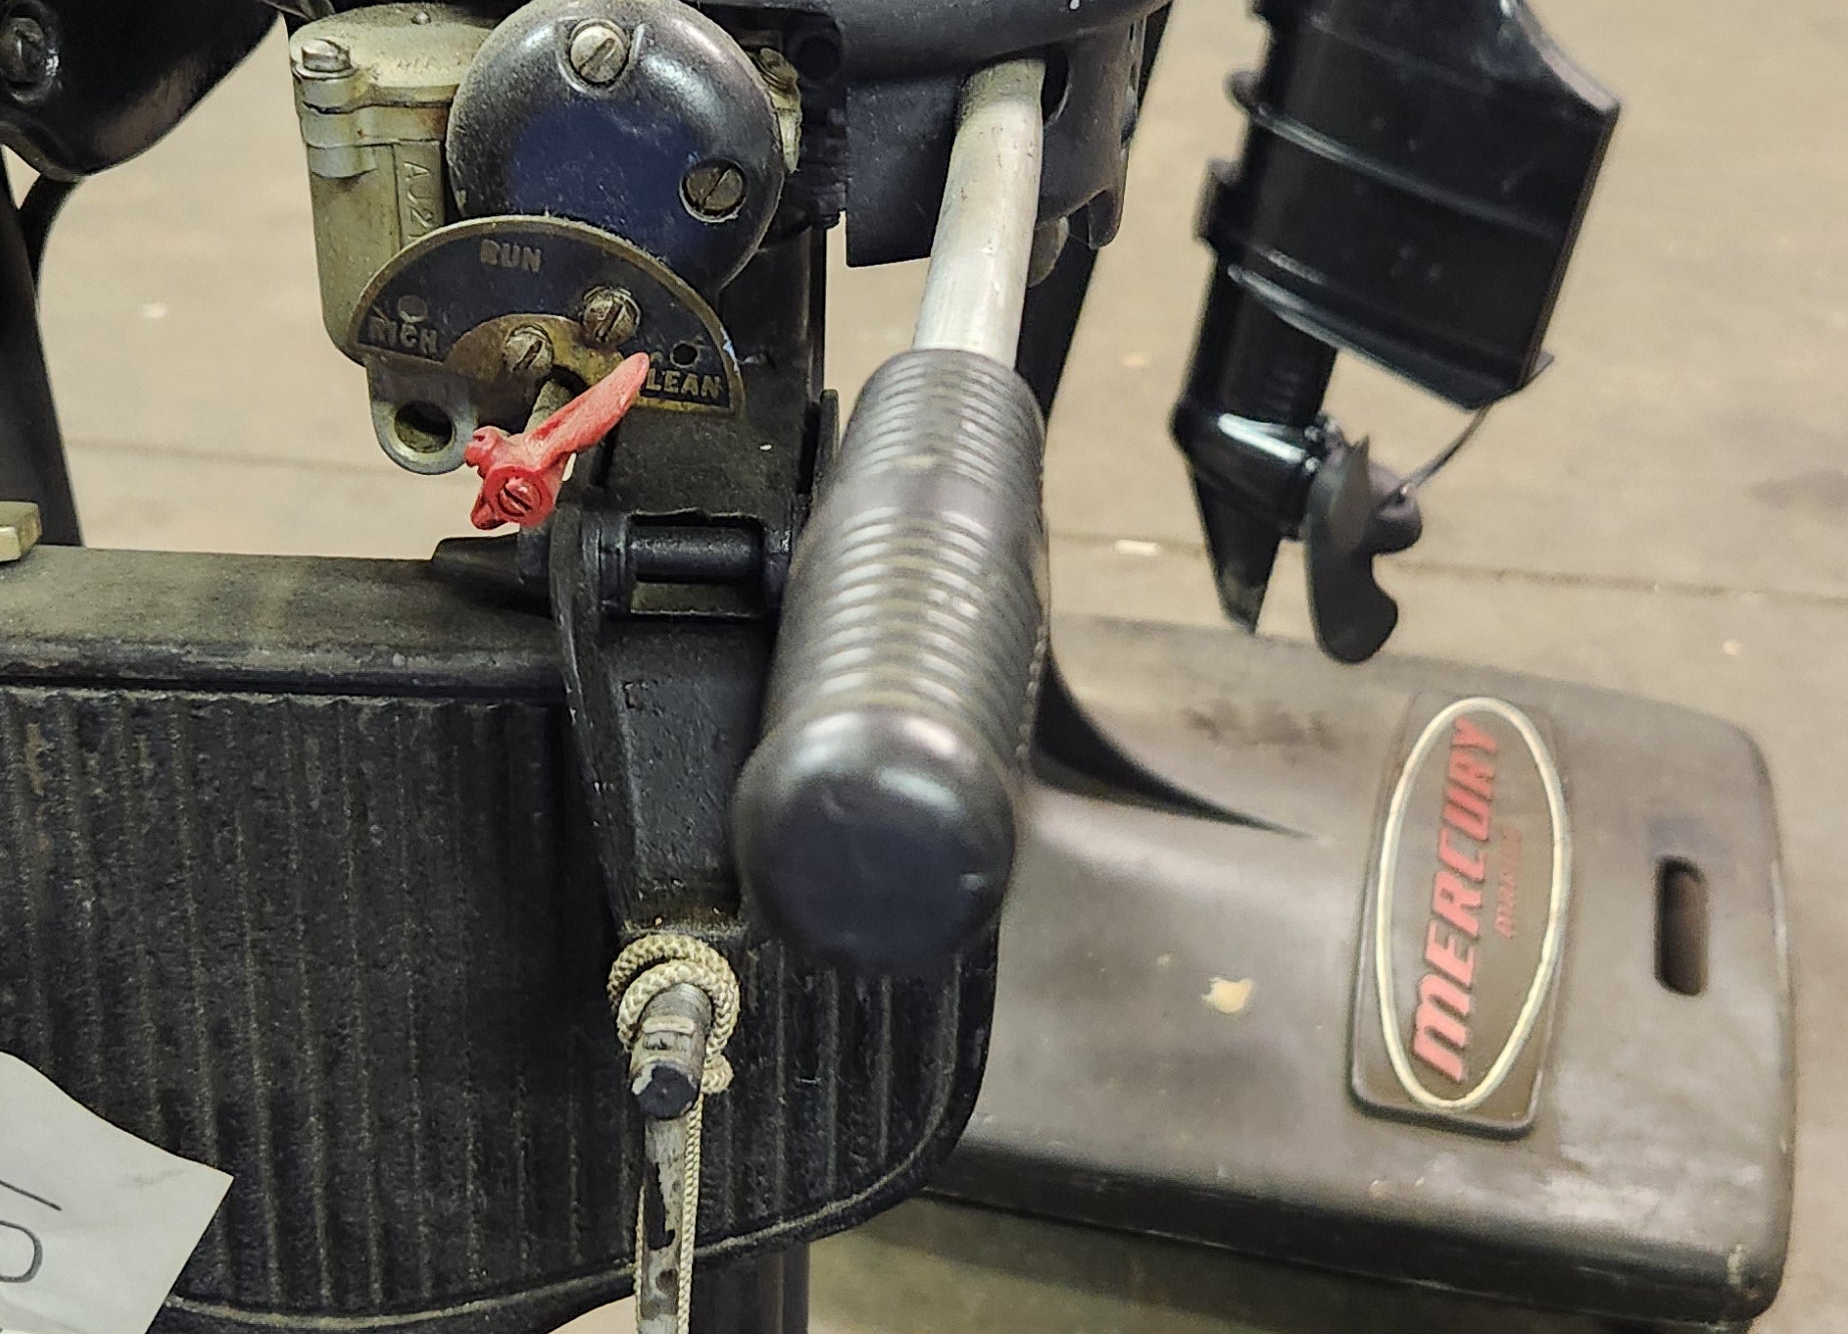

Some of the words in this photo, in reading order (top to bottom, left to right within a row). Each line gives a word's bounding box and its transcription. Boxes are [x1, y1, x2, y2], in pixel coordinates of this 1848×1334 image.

[480, 238, 542, 273] RUN
[645, 367, 723, 400] LEAN
[1411, 715, 1497, 1084] MERCURY
